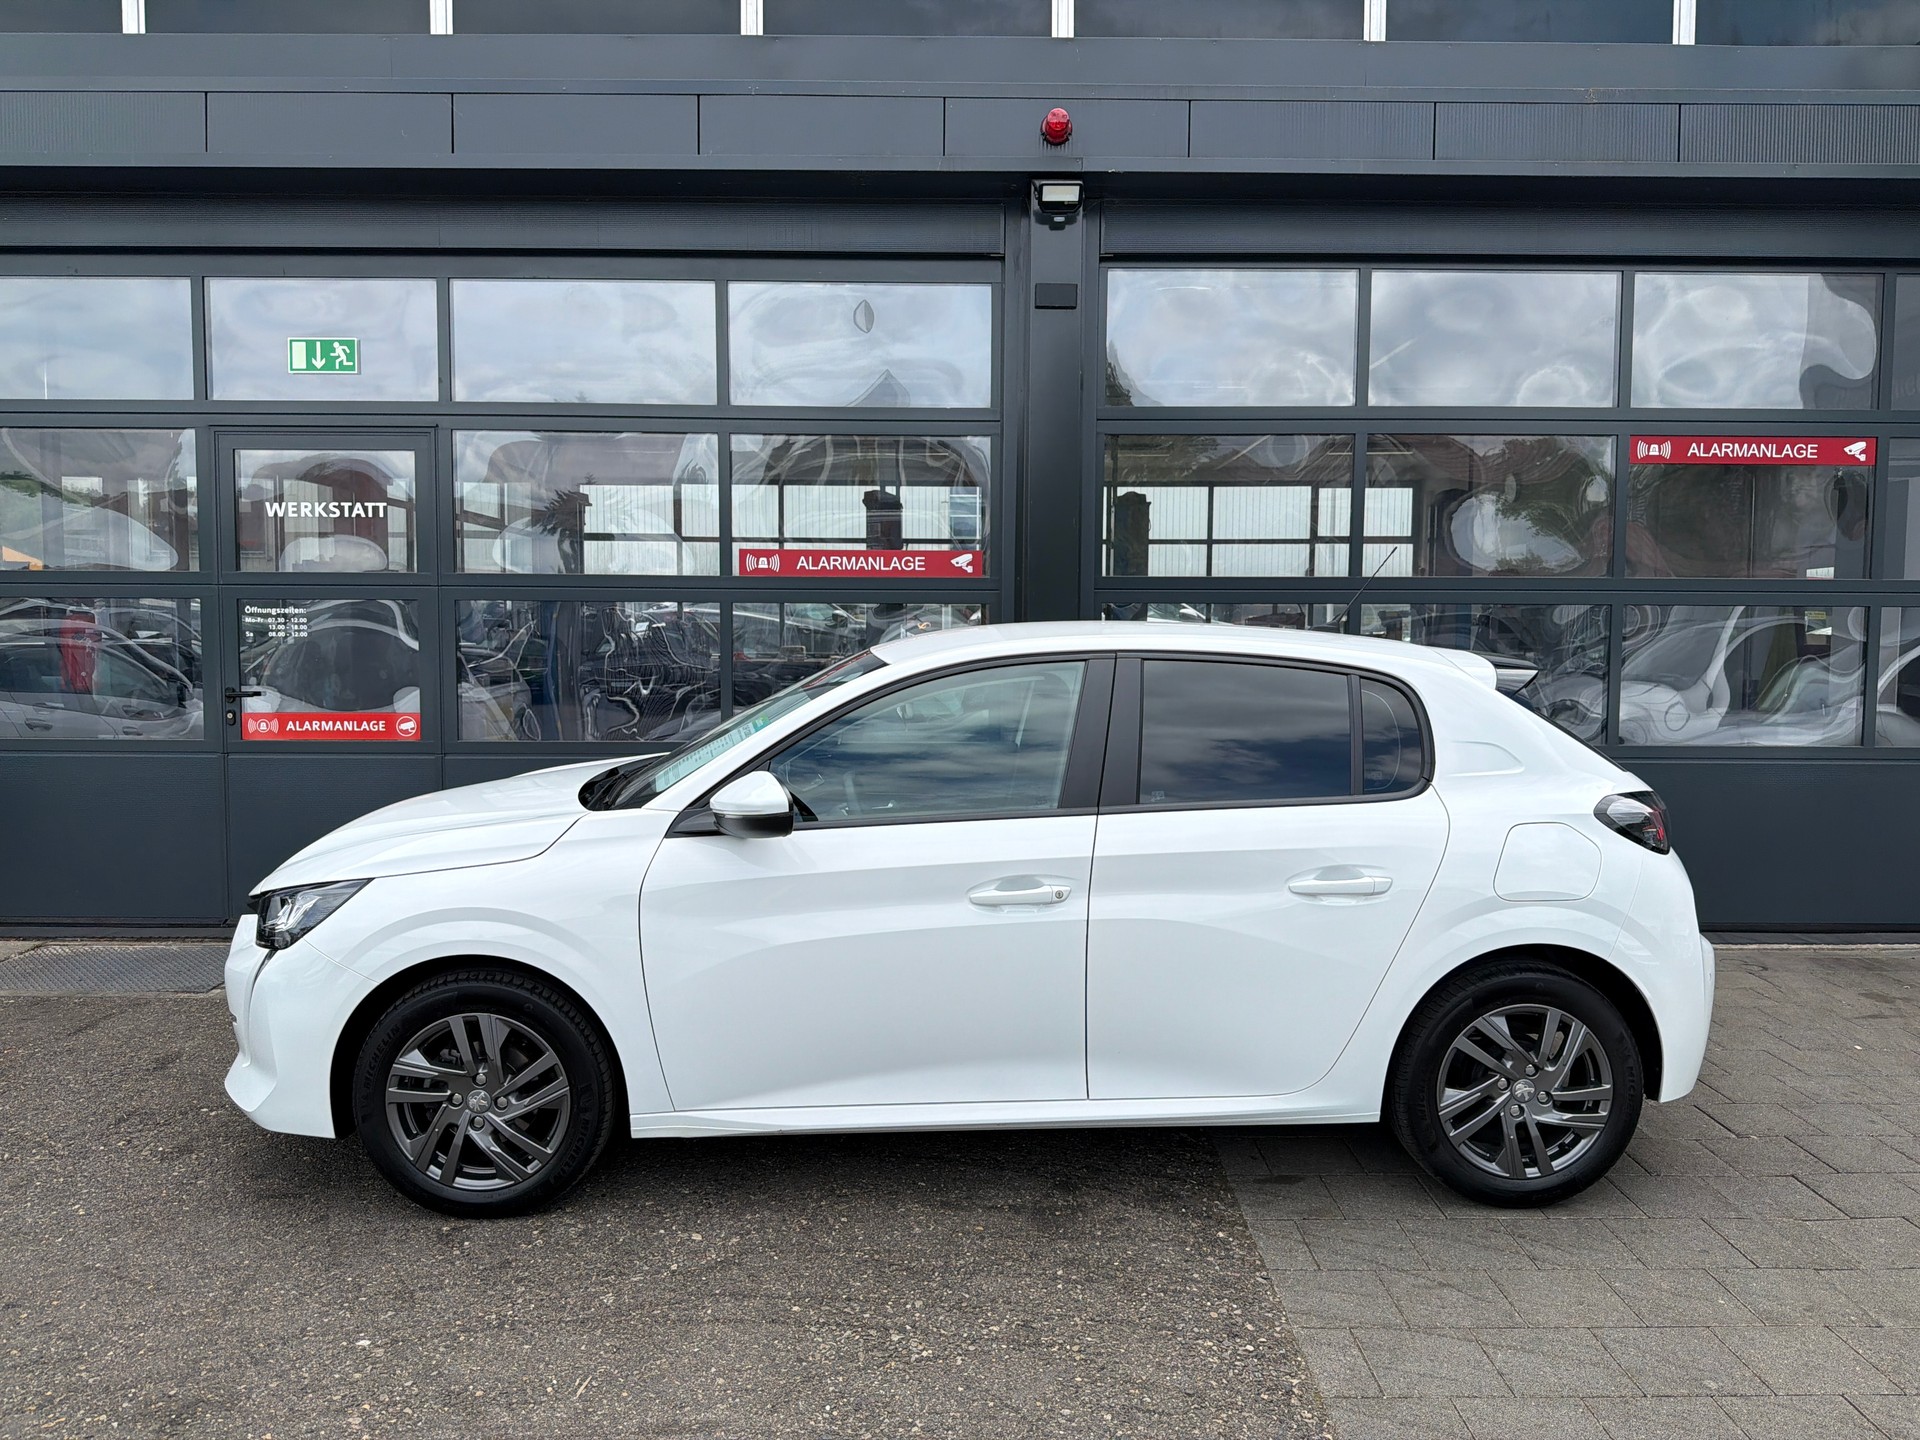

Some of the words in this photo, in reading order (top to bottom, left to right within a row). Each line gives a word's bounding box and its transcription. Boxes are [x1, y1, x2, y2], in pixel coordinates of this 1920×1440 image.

[1687, 442, 1818, 459] ALARMANLAGE
[265, 501, 387, 518] WERKSTATT
[796, 555, 926, 571] ALARMANLAGE
[244, 605, 307, 615] Öffnungszeiten:
[286, 720, 386, 732] ALARMANLAGE
[363, 1023, 401, 1090] MICHELIN
